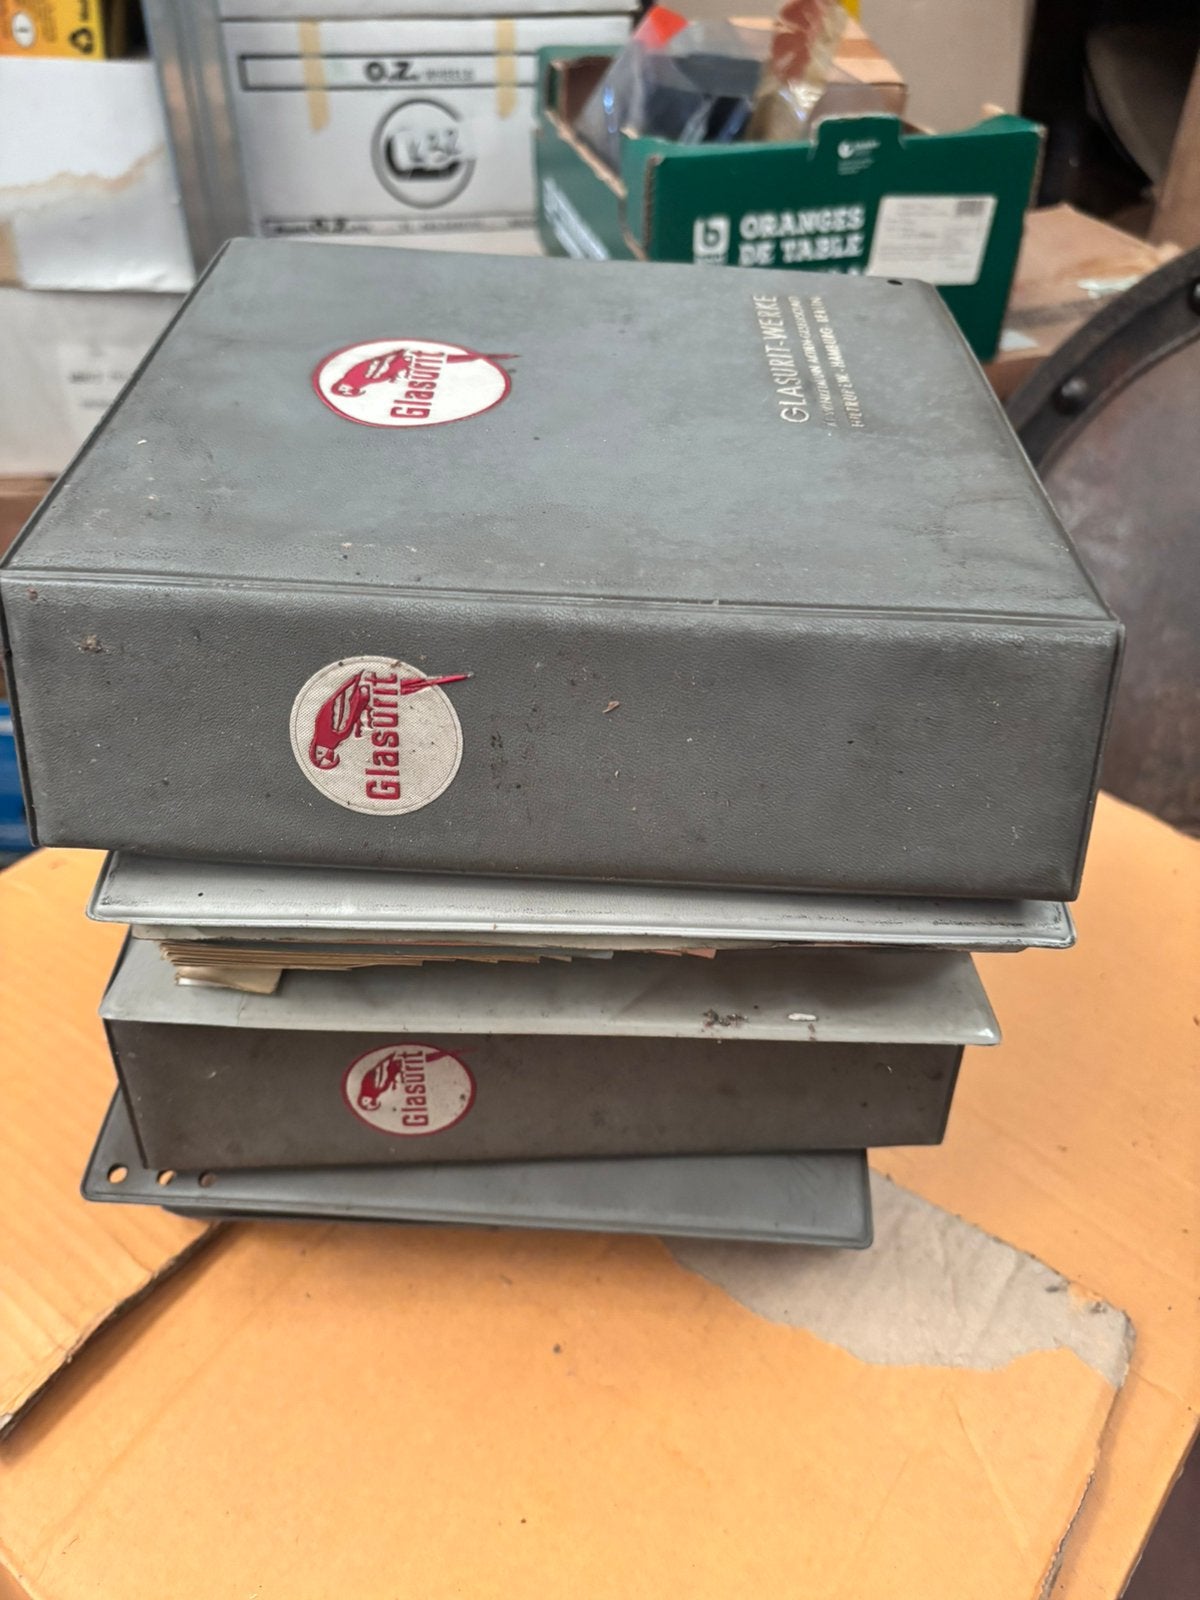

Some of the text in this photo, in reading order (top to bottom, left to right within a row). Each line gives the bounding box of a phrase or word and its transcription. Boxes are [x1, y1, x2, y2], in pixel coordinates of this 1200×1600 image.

[738, 204, 866, 240] ORANGES
[738, 241, 776, 266] DE
[780, 232, 866, 263] TABLE
[753, 296, 810, 423] GLASURIT-WERKE
[819, 327, 846, 368] HAMBURG
[390, 350, 446, 419] Glasurit
[365, 671, 401, 800] Glasurit
[398, 1050, 429, 1127] Glasurit
